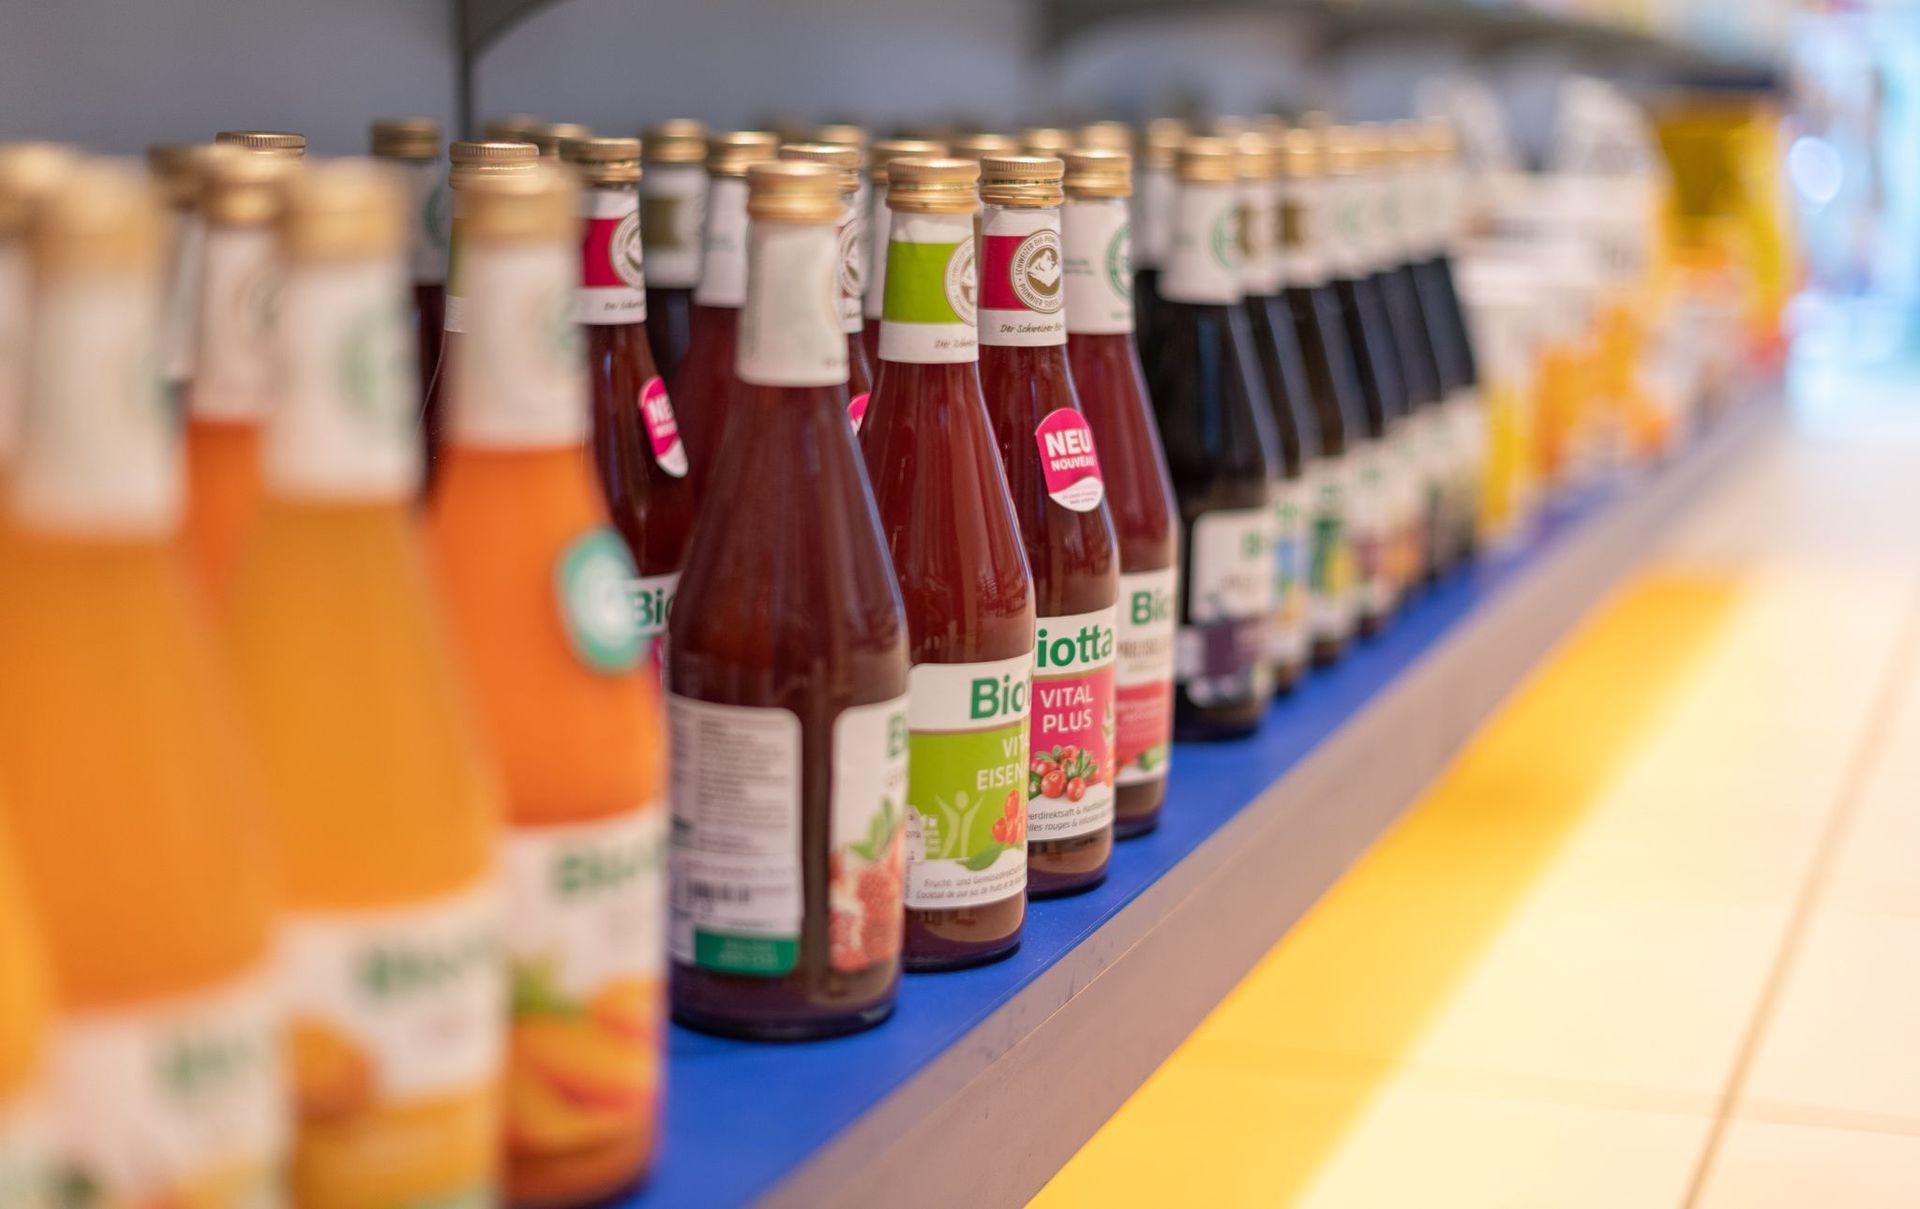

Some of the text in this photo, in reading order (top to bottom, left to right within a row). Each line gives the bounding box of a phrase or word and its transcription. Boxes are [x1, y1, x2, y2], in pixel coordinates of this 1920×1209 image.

[1045, 429, 1092, 458] NEU
[1036, 624, 1113, 668] iotta
[1040, 684, 1094, 709] VITAL
[1042, 708, 1093, 734] PLUS
[1028, 808, 1075, 821] erdirektsaft
